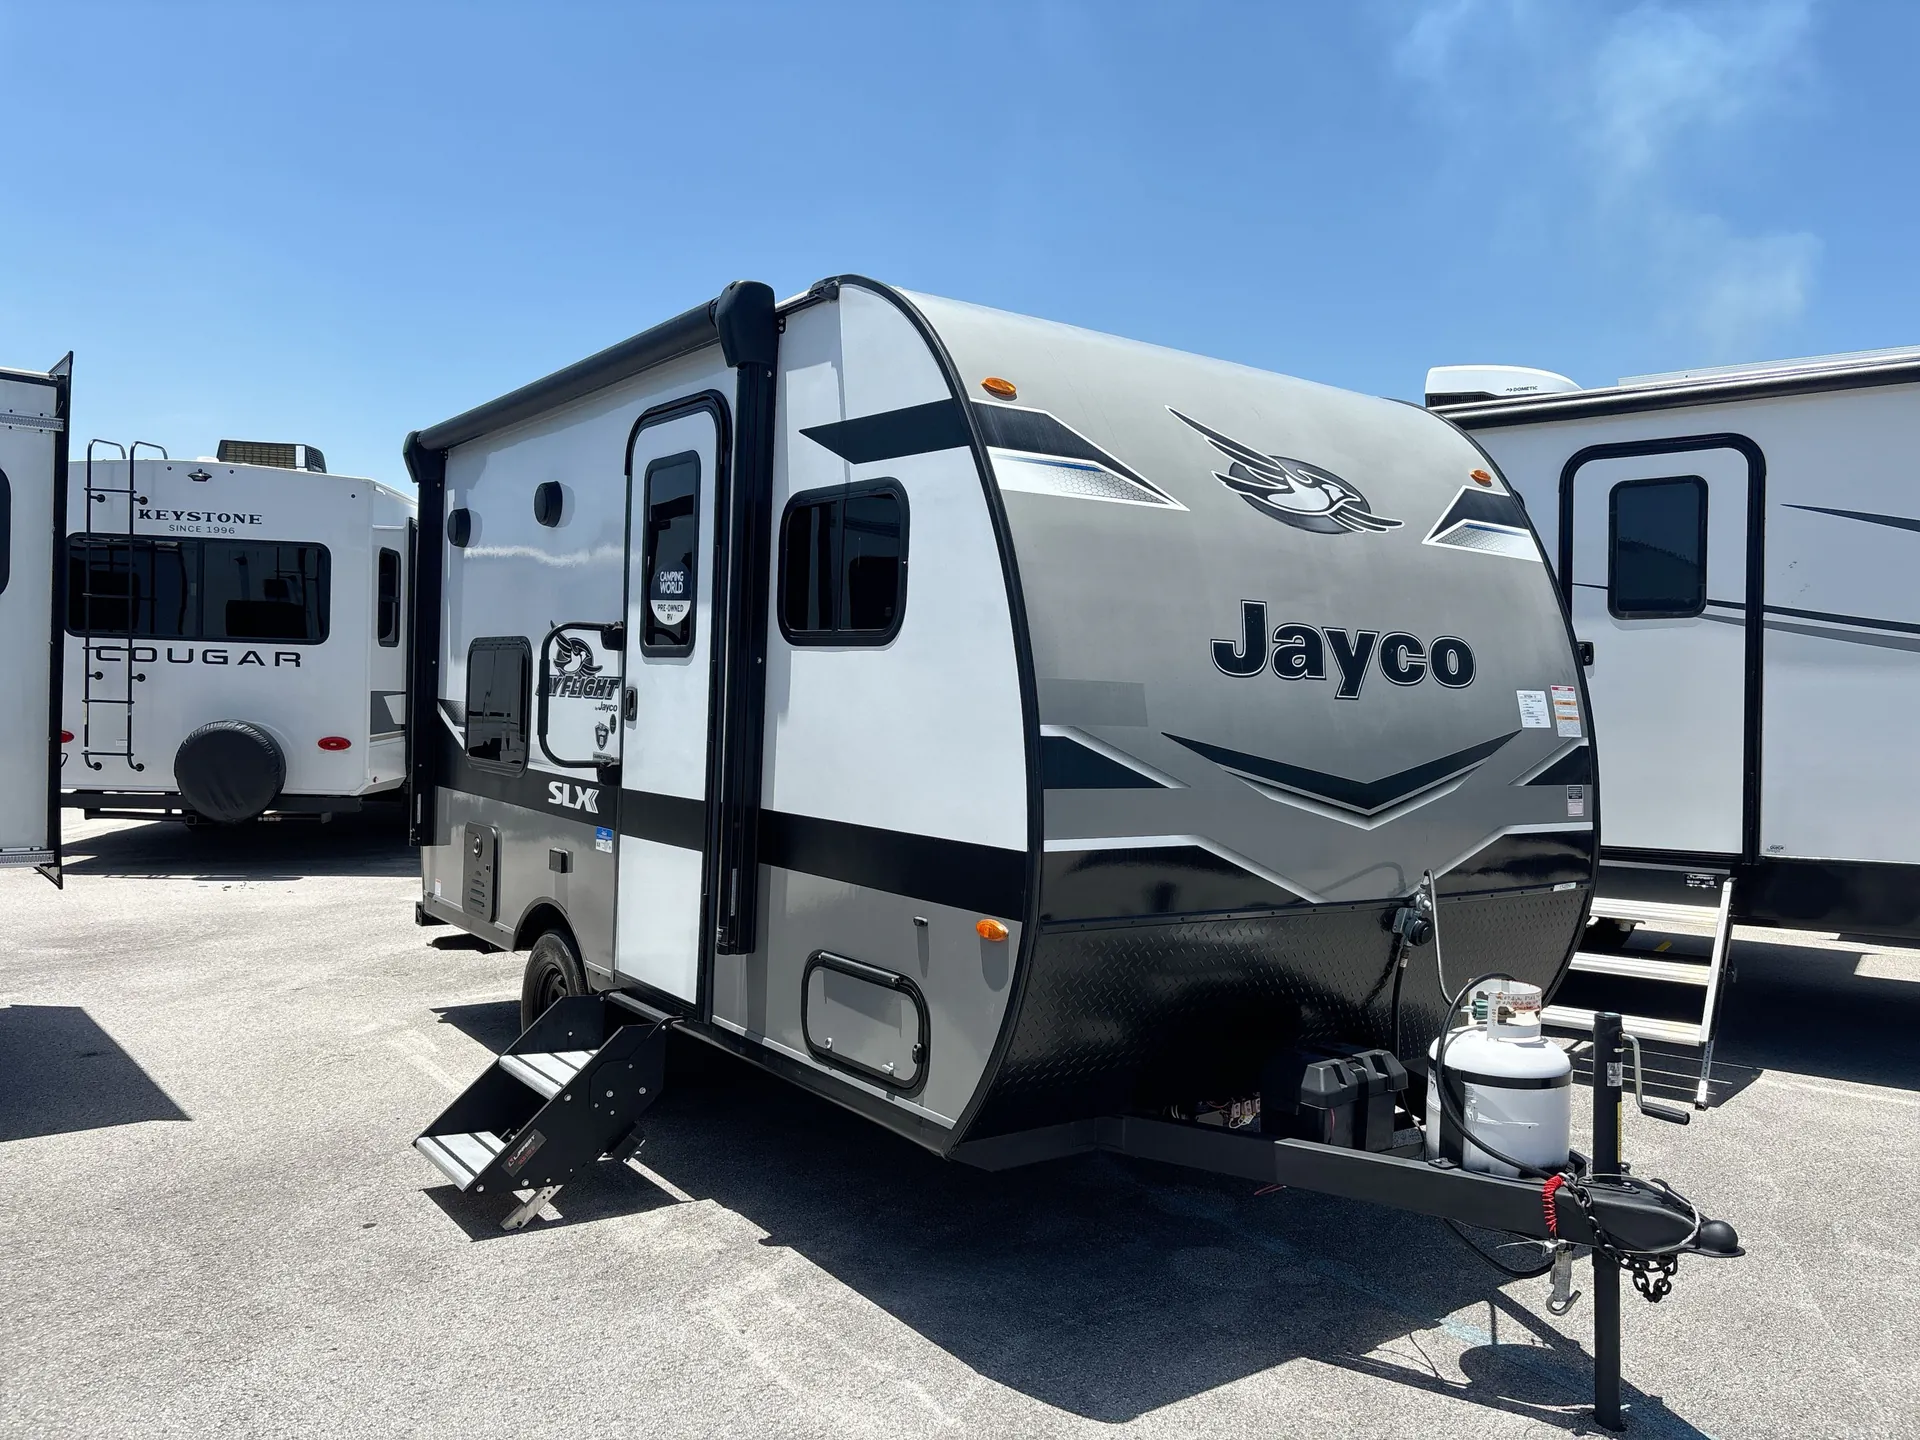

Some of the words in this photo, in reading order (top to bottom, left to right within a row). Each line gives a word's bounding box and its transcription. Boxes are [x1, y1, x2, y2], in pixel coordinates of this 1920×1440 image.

[138, 509, 262, 525] KEYSTONE
[169, 524, 202, 533] SINCE
[207, 526, 236, 534] 1996
[660, 571, 684, 581] CAMPING
[660, 581, 684, 594] WORLD
[657, 604, 685, 612] PRE-OWNED
[667, 613, 674, 621] RV
[1210, 599, 1476, 700] Jayco
[96, 646, 301, 667] COUGAR
[559, 675, 622, 700] FLIGHT
[600, 702, 618, 713] Jayco
[548, 781, 599, 814] SLX
